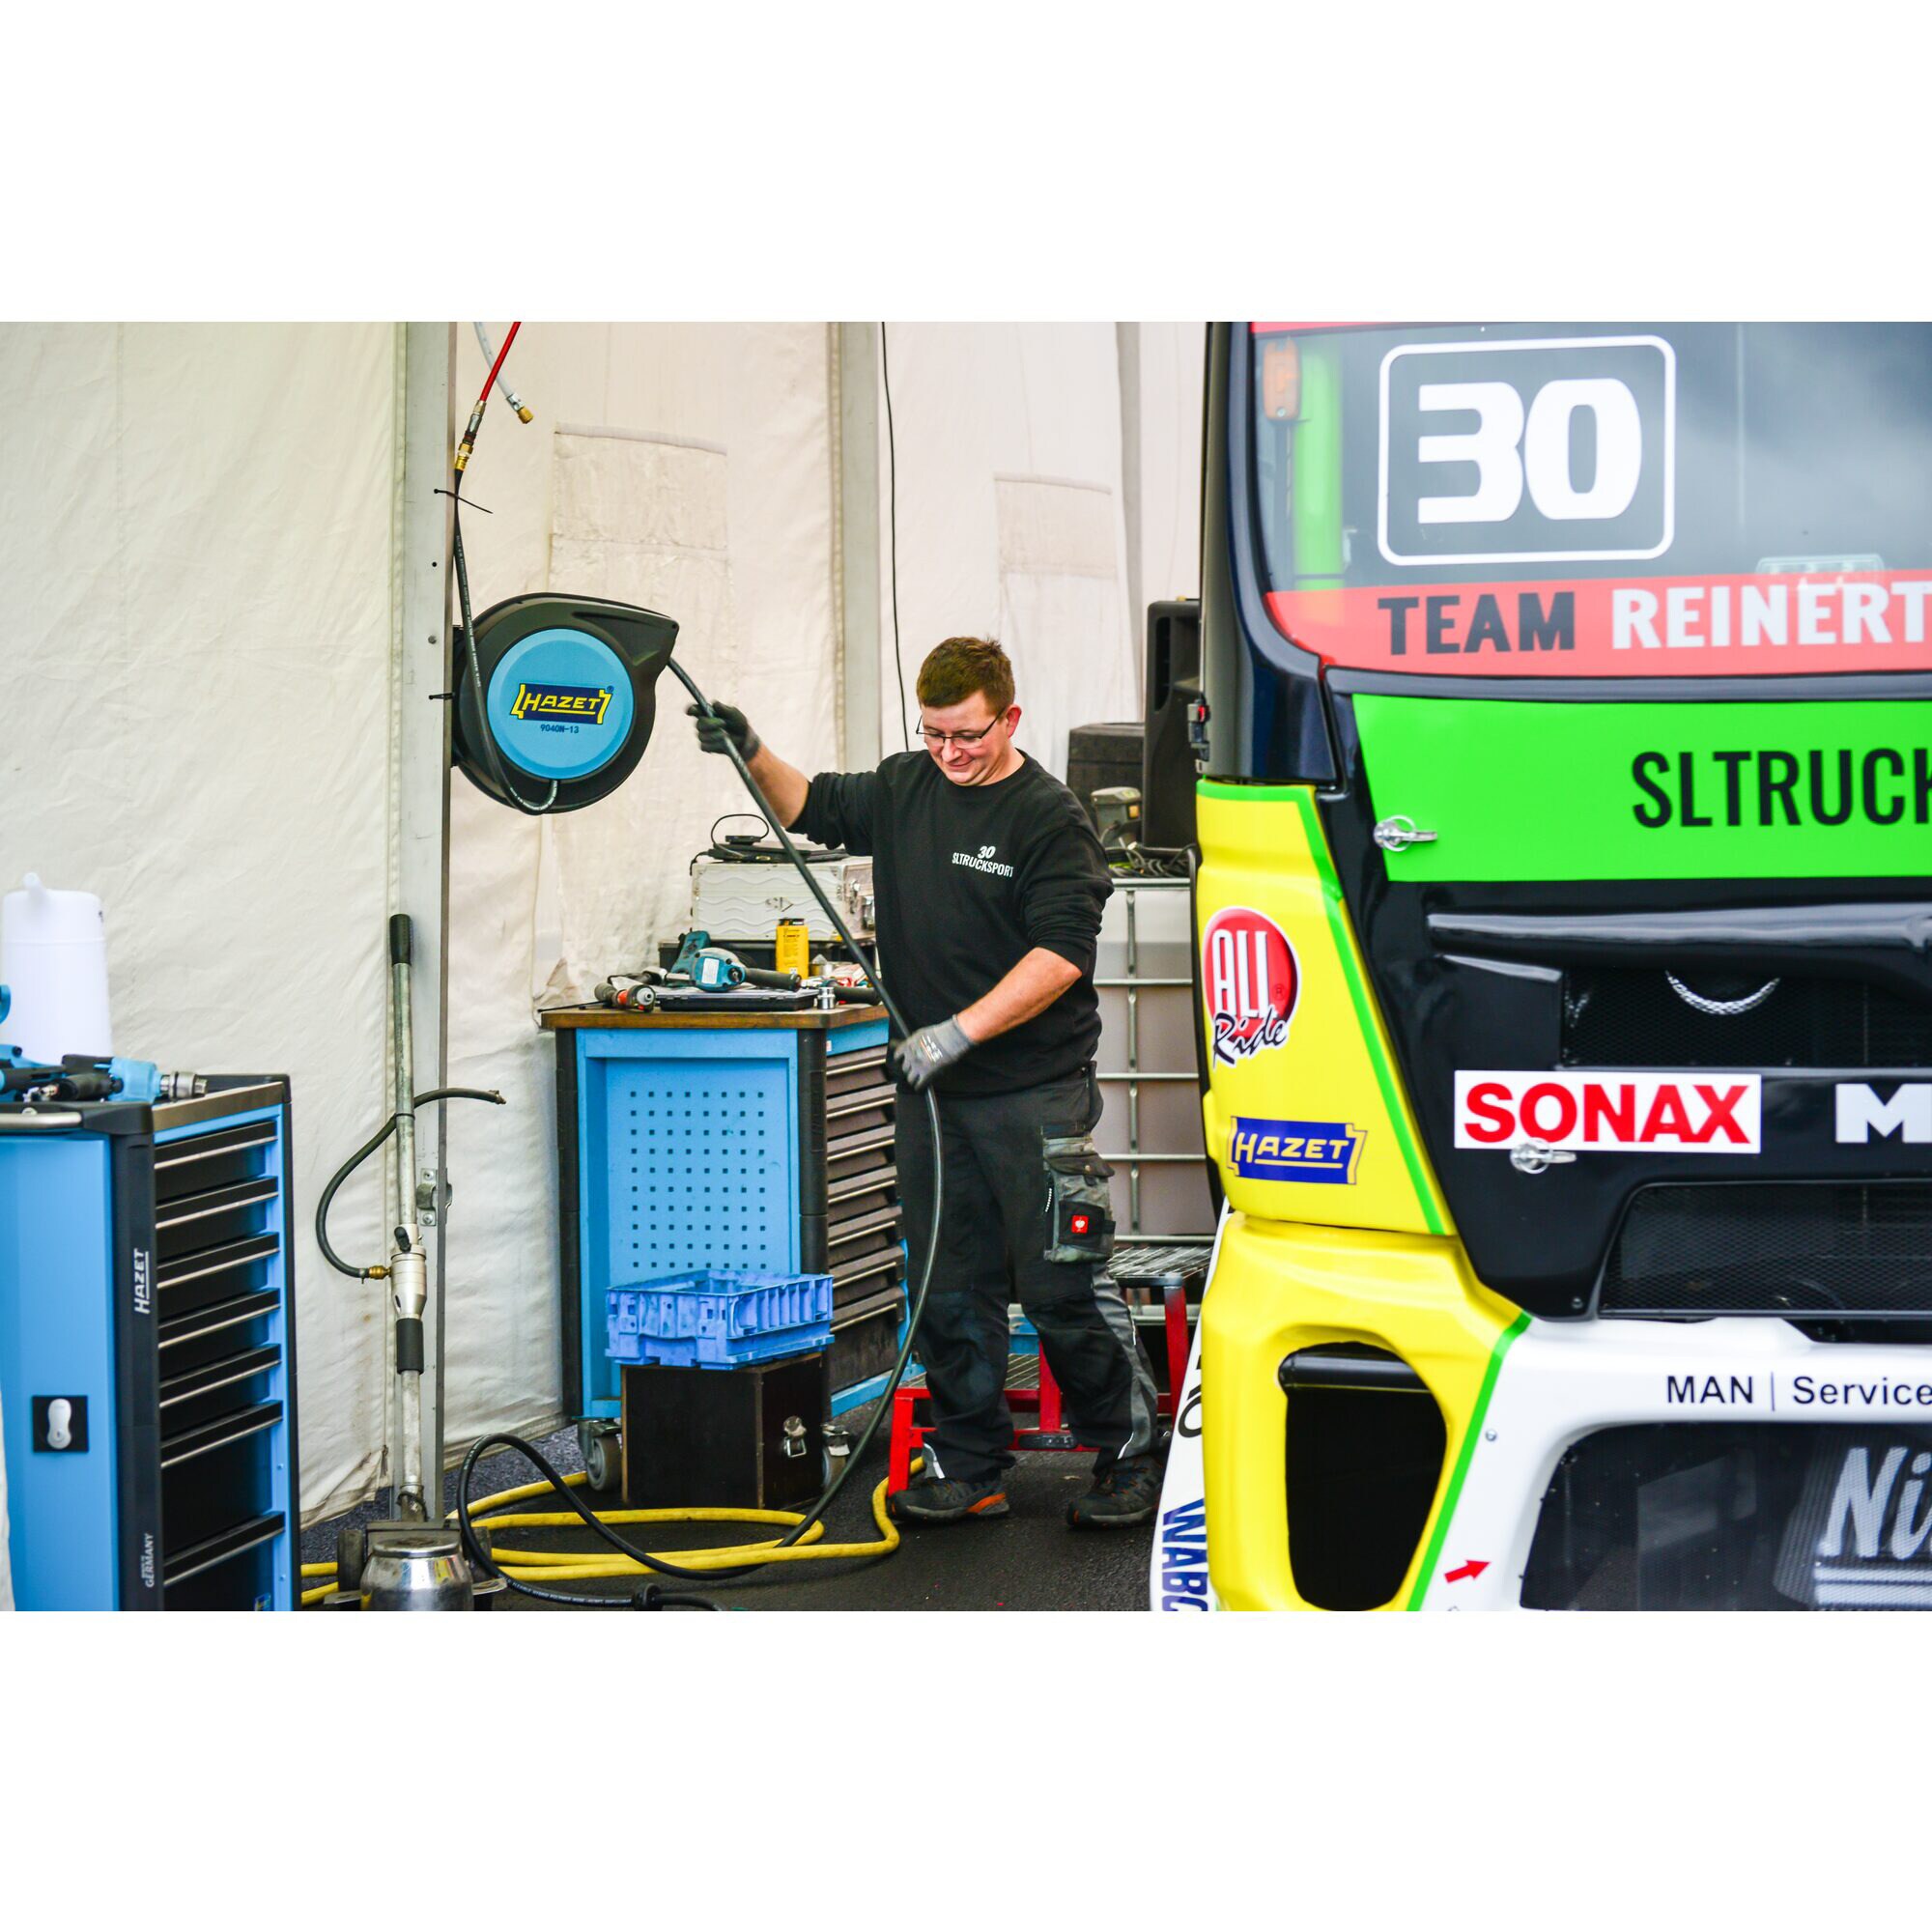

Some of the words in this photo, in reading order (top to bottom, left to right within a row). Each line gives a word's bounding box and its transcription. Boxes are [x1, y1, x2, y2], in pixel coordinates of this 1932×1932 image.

[1418, 378, 1642, 524] 30
[1378, 591, 1576, 656] TEAM
[1612, 581, 1932, 649] REINERT
[522, 693, 601, 715] HAZET
[952, 852, 1014, 877] SLTRUCKSPORT
[978, 845, 996, 859] 30
[1213, 1010, 1287, 1068] Ride
[1464, 1082, 1750, 1144] SONAX
[1235, 1132, 1350, 1168] HAZET
[134, 1248, 150, 1314] HAZET
[1667, 1376, 1753, 1404] MAN
[1793, 1376, 1932, 1406] Service
[144, 1533, 155, 1588] GERMANY
